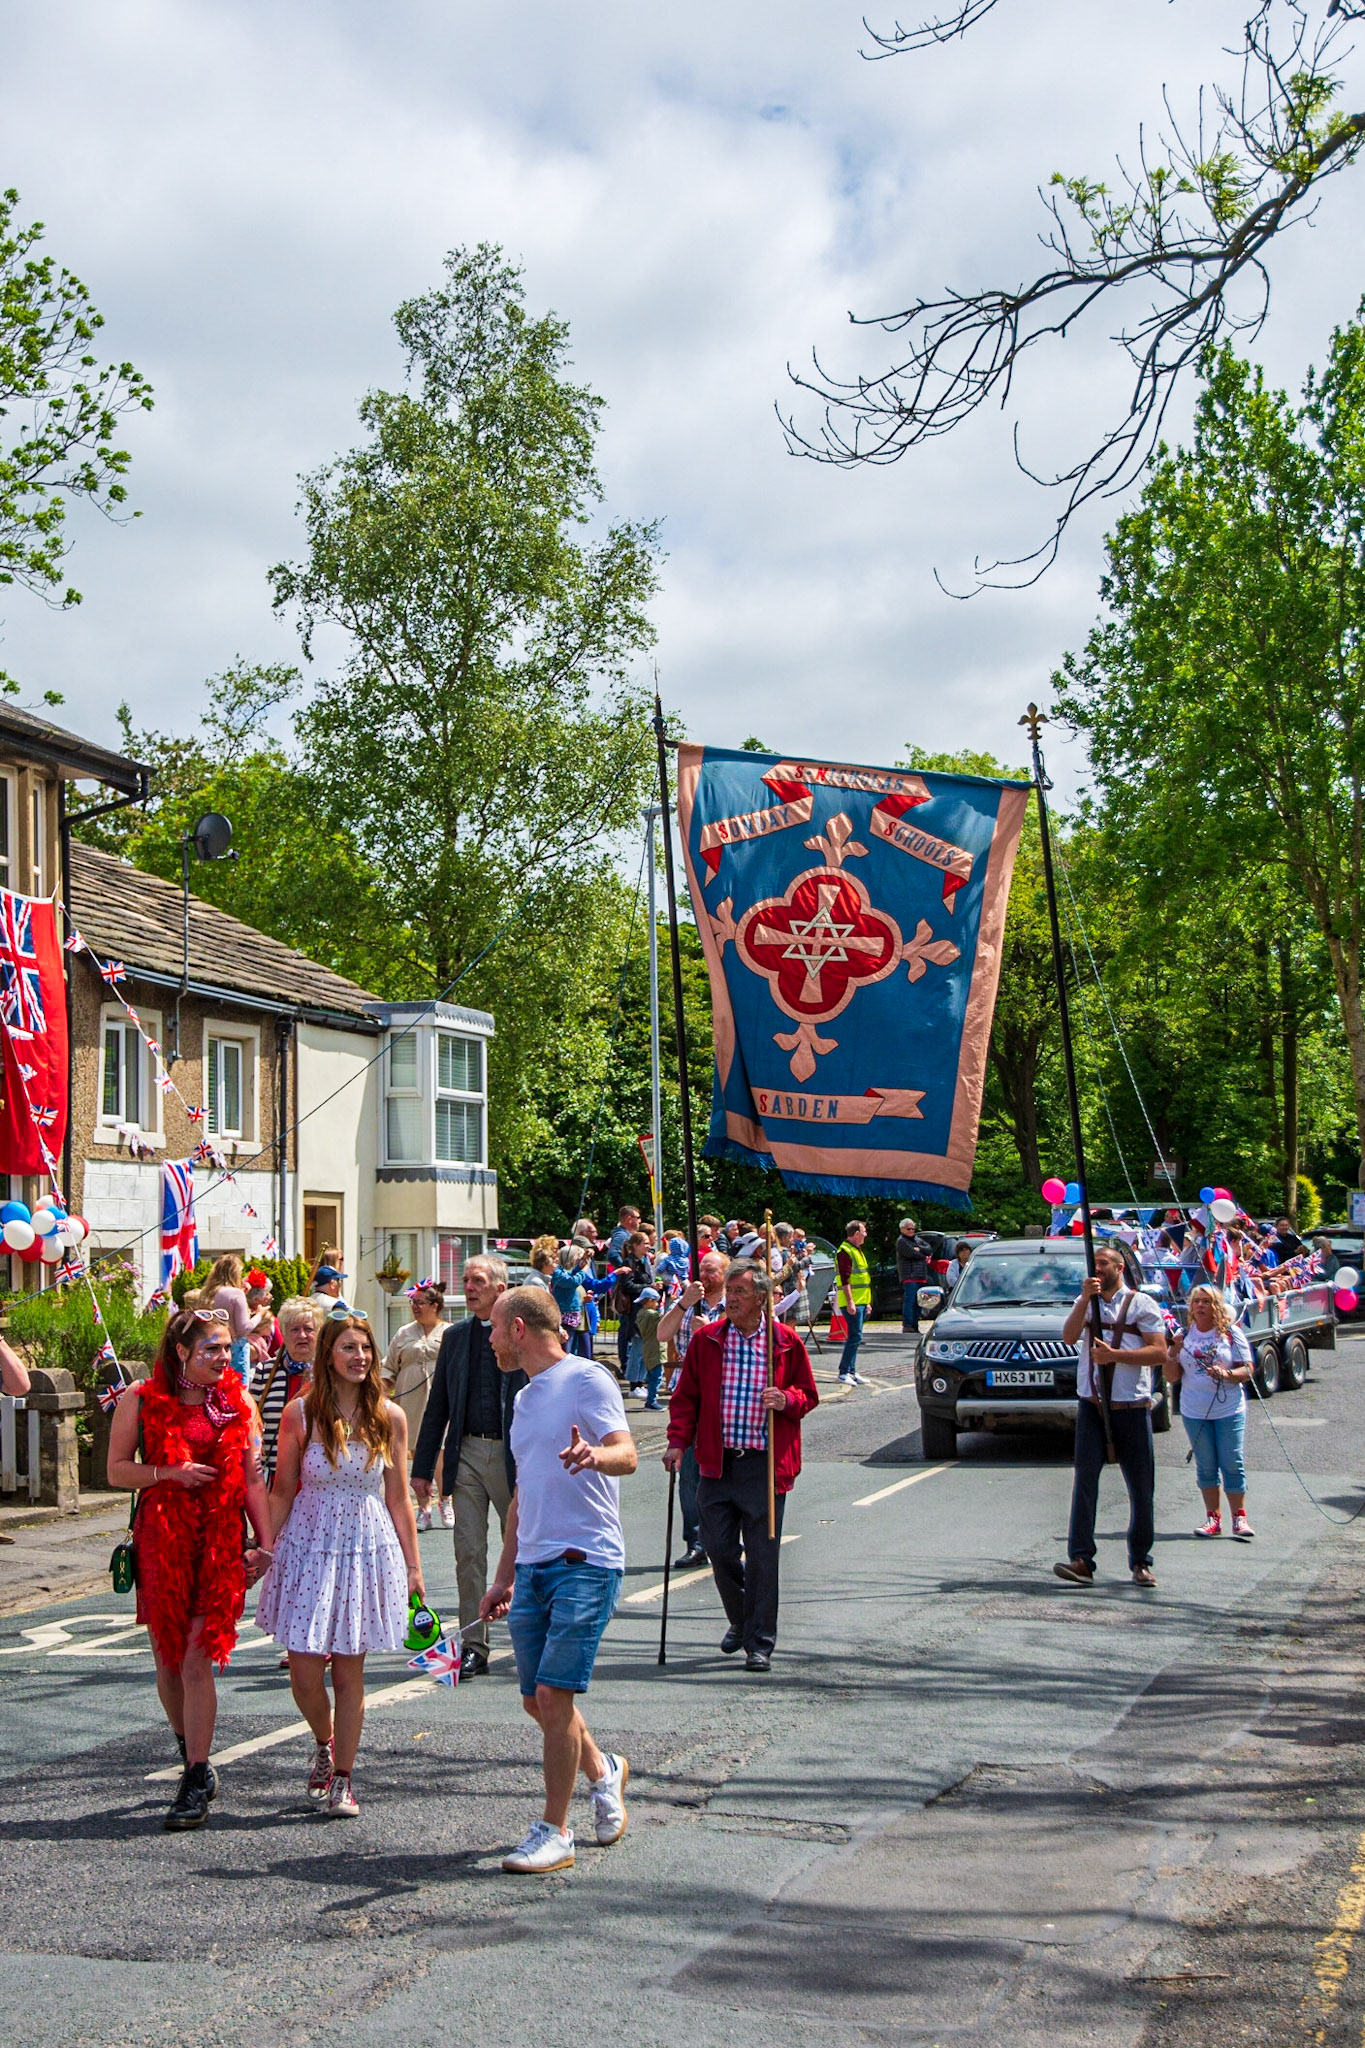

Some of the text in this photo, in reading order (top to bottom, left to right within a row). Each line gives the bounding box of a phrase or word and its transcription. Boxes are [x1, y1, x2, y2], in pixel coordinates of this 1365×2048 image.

[718, 806, 956, 866] SUNDAY SCHOOLS
[760, 1094, 839, 1119] SABDEN
[995, 1372, 1025, 1383] HX63
